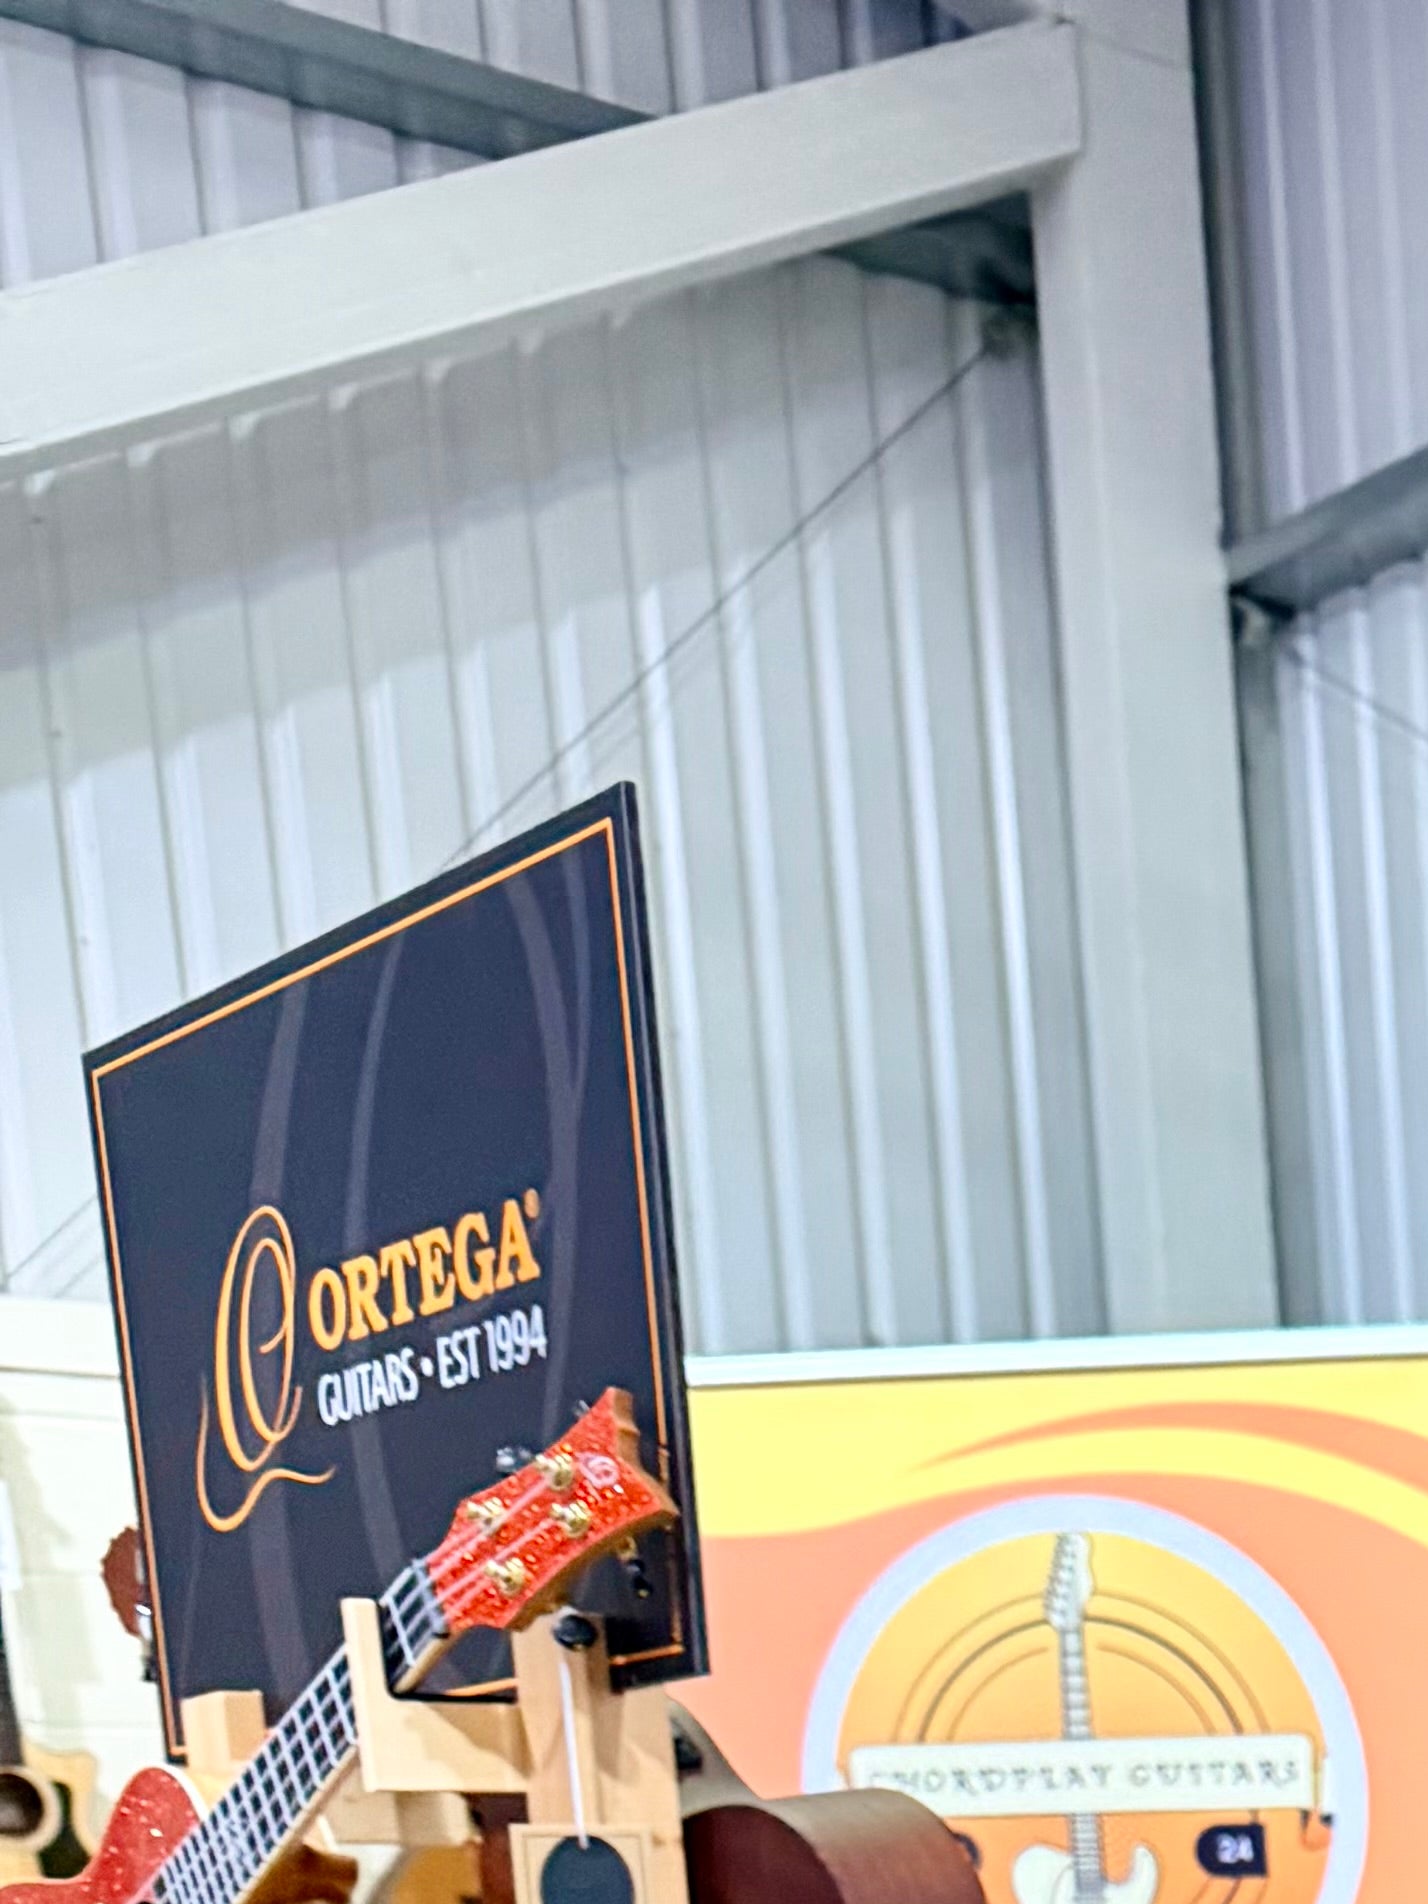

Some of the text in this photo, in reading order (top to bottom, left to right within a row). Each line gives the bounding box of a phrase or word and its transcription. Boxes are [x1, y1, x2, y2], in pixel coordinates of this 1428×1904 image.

[316, 1304, 548, 1427] GUITARS EST 1994
[1127, 1757, 1300, 1791] GUITARS
